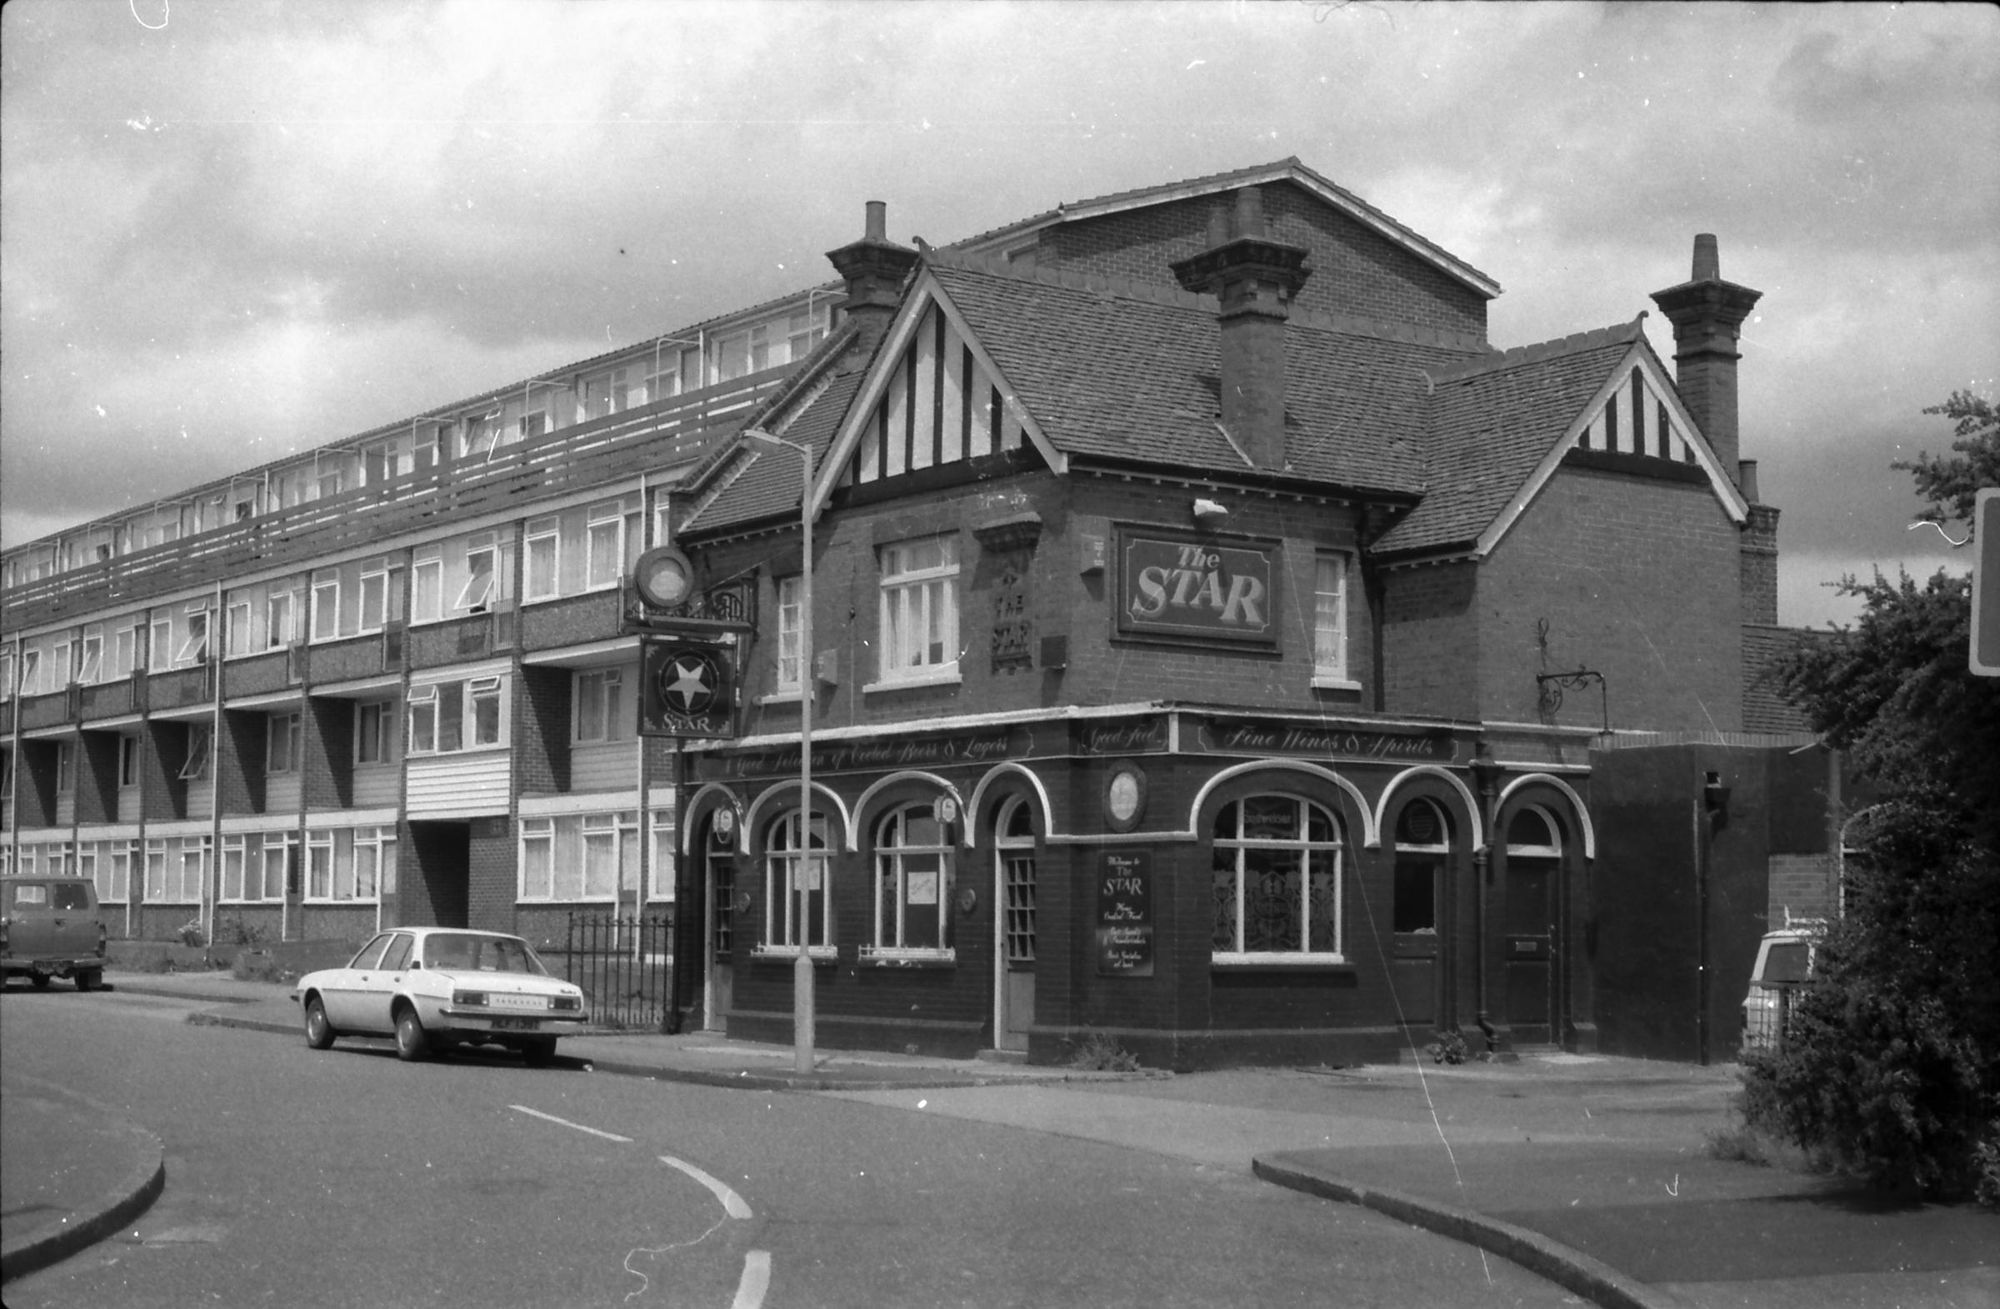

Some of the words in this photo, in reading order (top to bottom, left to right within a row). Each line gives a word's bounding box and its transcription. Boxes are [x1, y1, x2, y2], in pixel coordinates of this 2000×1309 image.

[1178, 546, 1220, 568] The
[1131, 565, 1266, 625] STAR
[662, 712, 713, 733] STAR
[960, 736, 1009, 761] Lagers
[1226, 727, 1276, 747] Fine
[1281, 728, 1339, 750] Wines
[1342, 734, 1363, 755] &
[1367, 735, 1434, 758] Spirits
[1103, 878, 1144, 896] STAR
